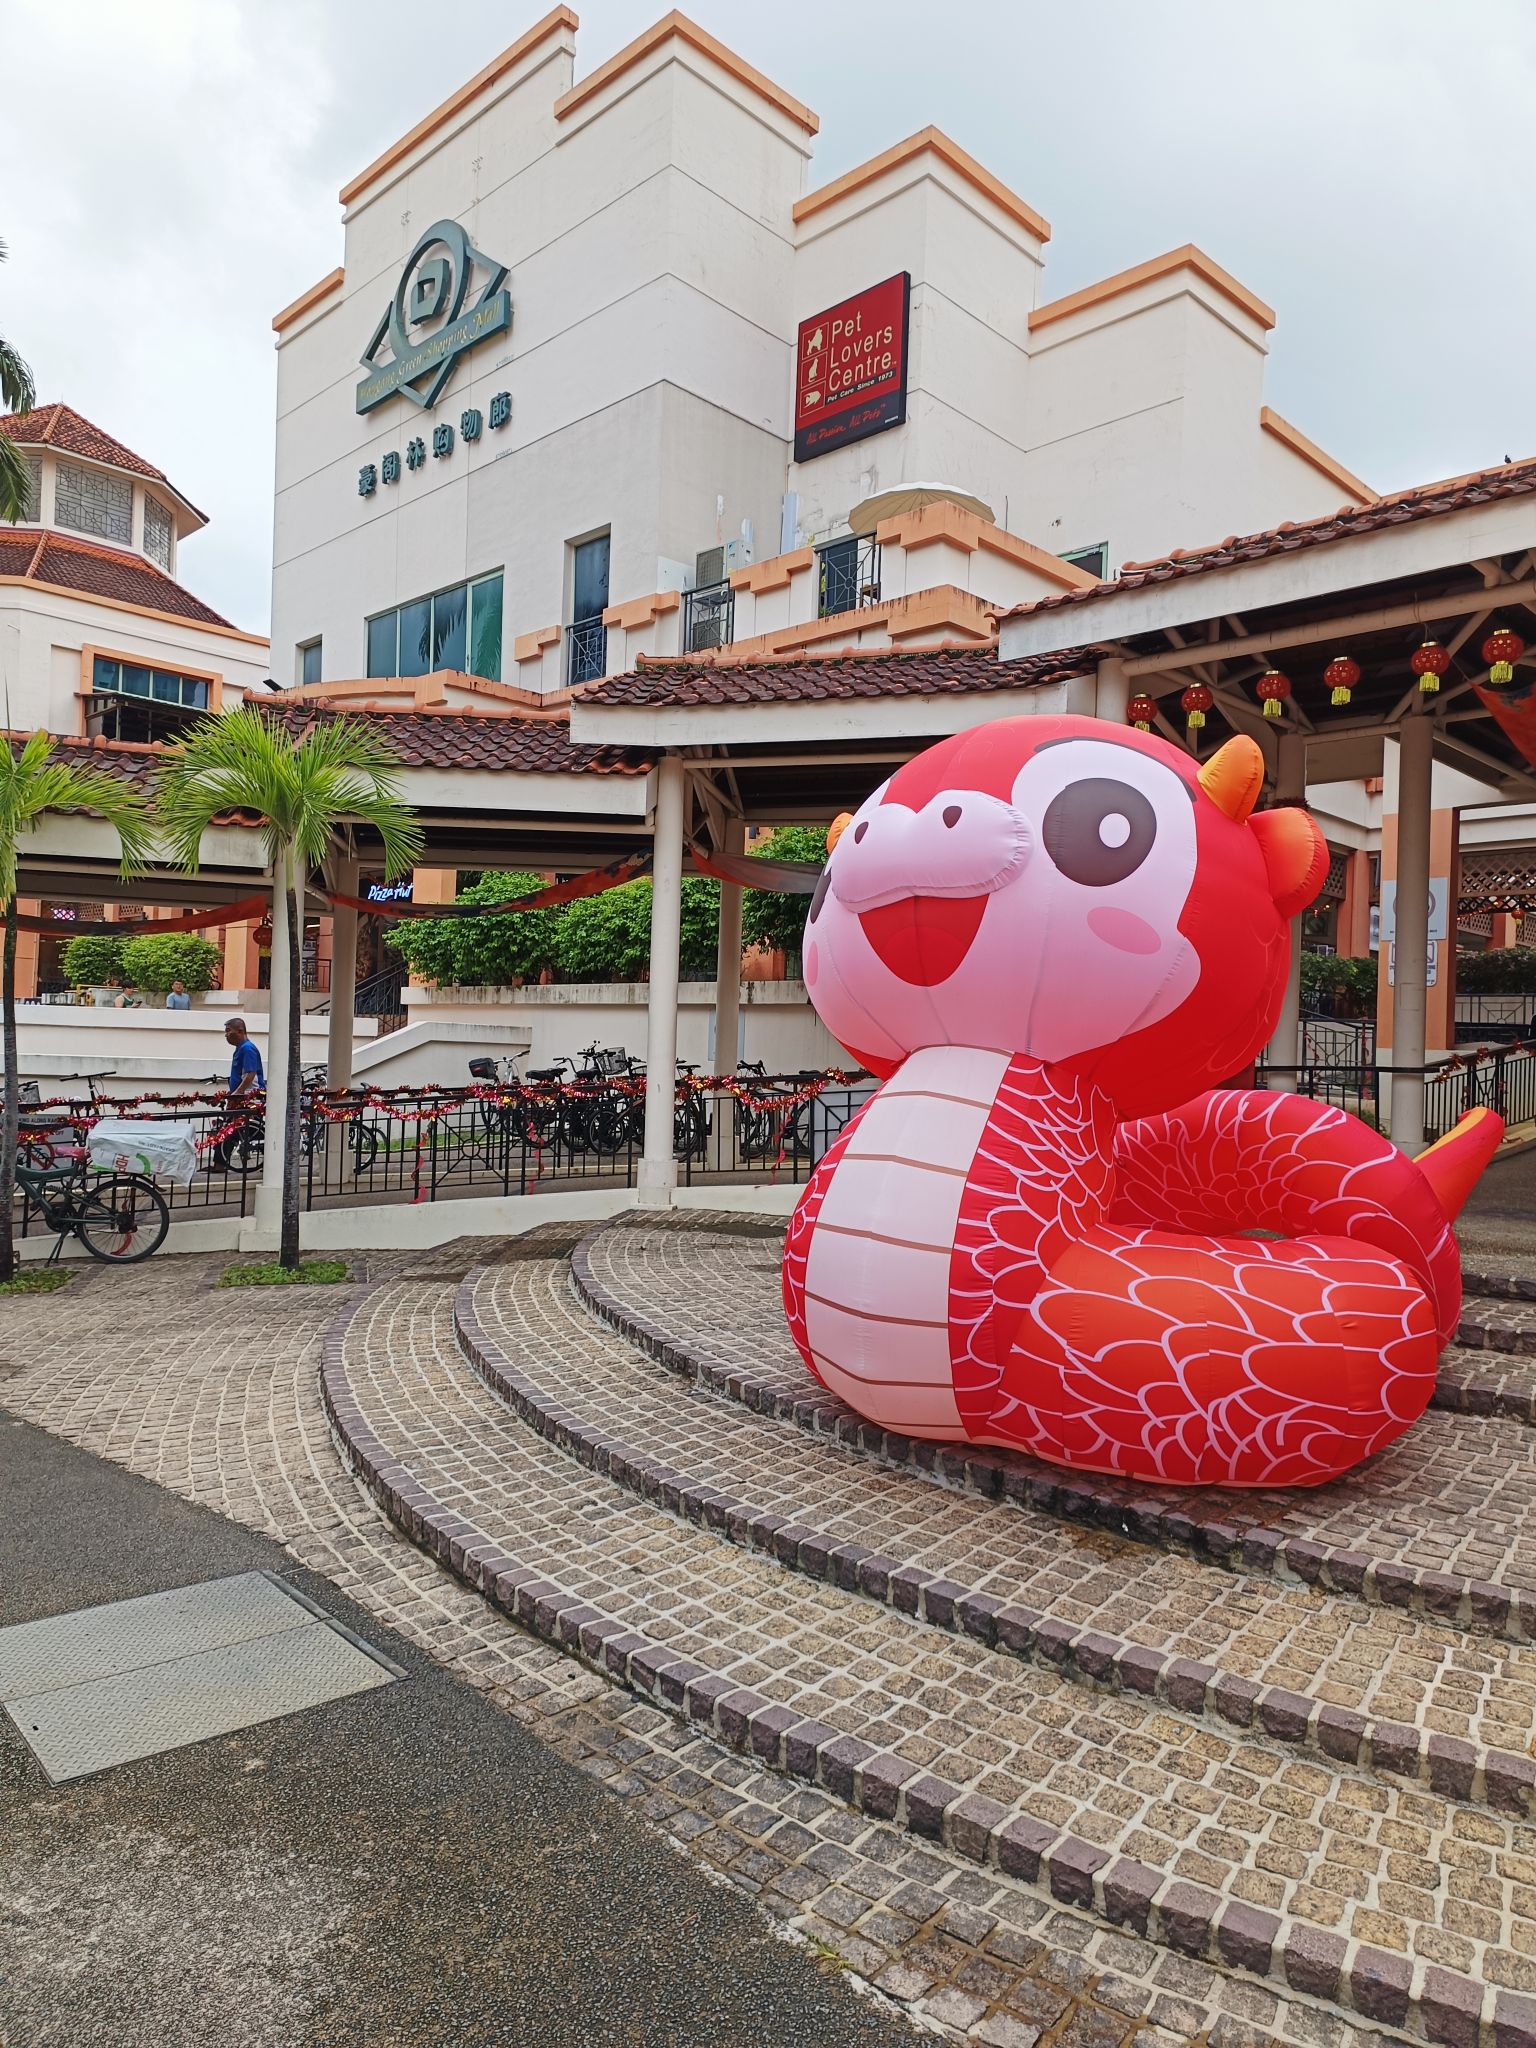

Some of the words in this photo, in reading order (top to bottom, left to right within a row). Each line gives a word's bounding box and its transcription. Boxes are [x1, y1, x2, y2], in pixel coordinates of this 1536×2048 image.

[398, 354, 423, 375] Green
[427, 325, 468, 355] Shopping
[470, 300, 500, 339] Mall
[831, 310, 862, 344] Pet
[830, 325, 893, 369] Lovers
[827, 395, 838, 403] Pet
[840, 388, 855, 398] Care
[856, 379, 875, 390] Since
[878, 370, 893, 382] 1973
[828, 351, 892, 392] Centre
[367, 885, 394, 902] Pizza
[393, 881, 415, 900] Hut
